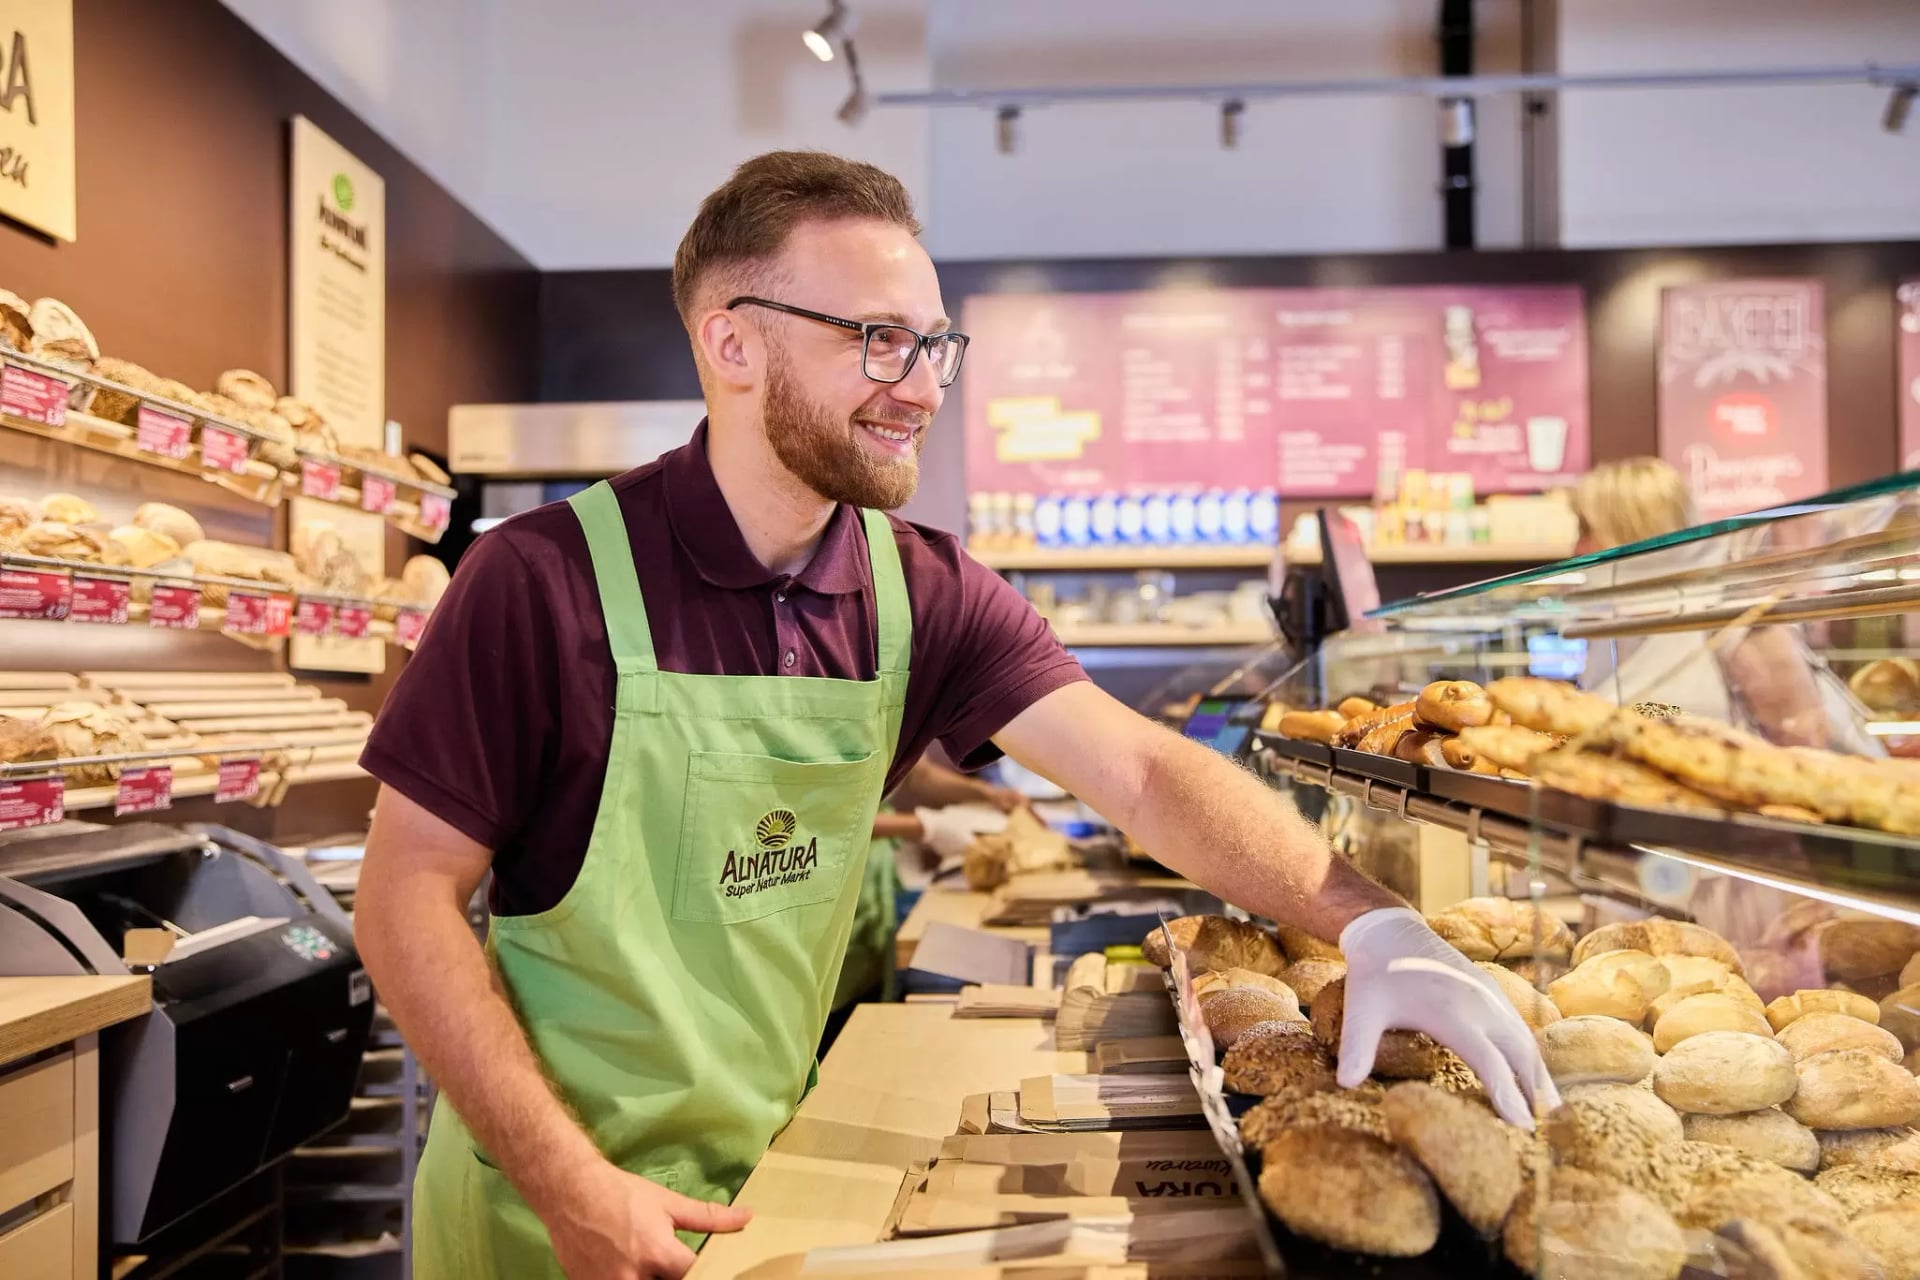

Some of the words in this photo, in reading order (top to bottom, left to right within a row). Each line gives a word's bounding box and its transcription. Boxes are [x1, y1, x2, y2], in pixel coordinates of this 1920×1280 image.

[719, 837, 818, 884] ALNATURA
[726, 884, 756, 899] Super
[755, 875, 781, 893] Natur
[781, 870, 811, 885] Markt
